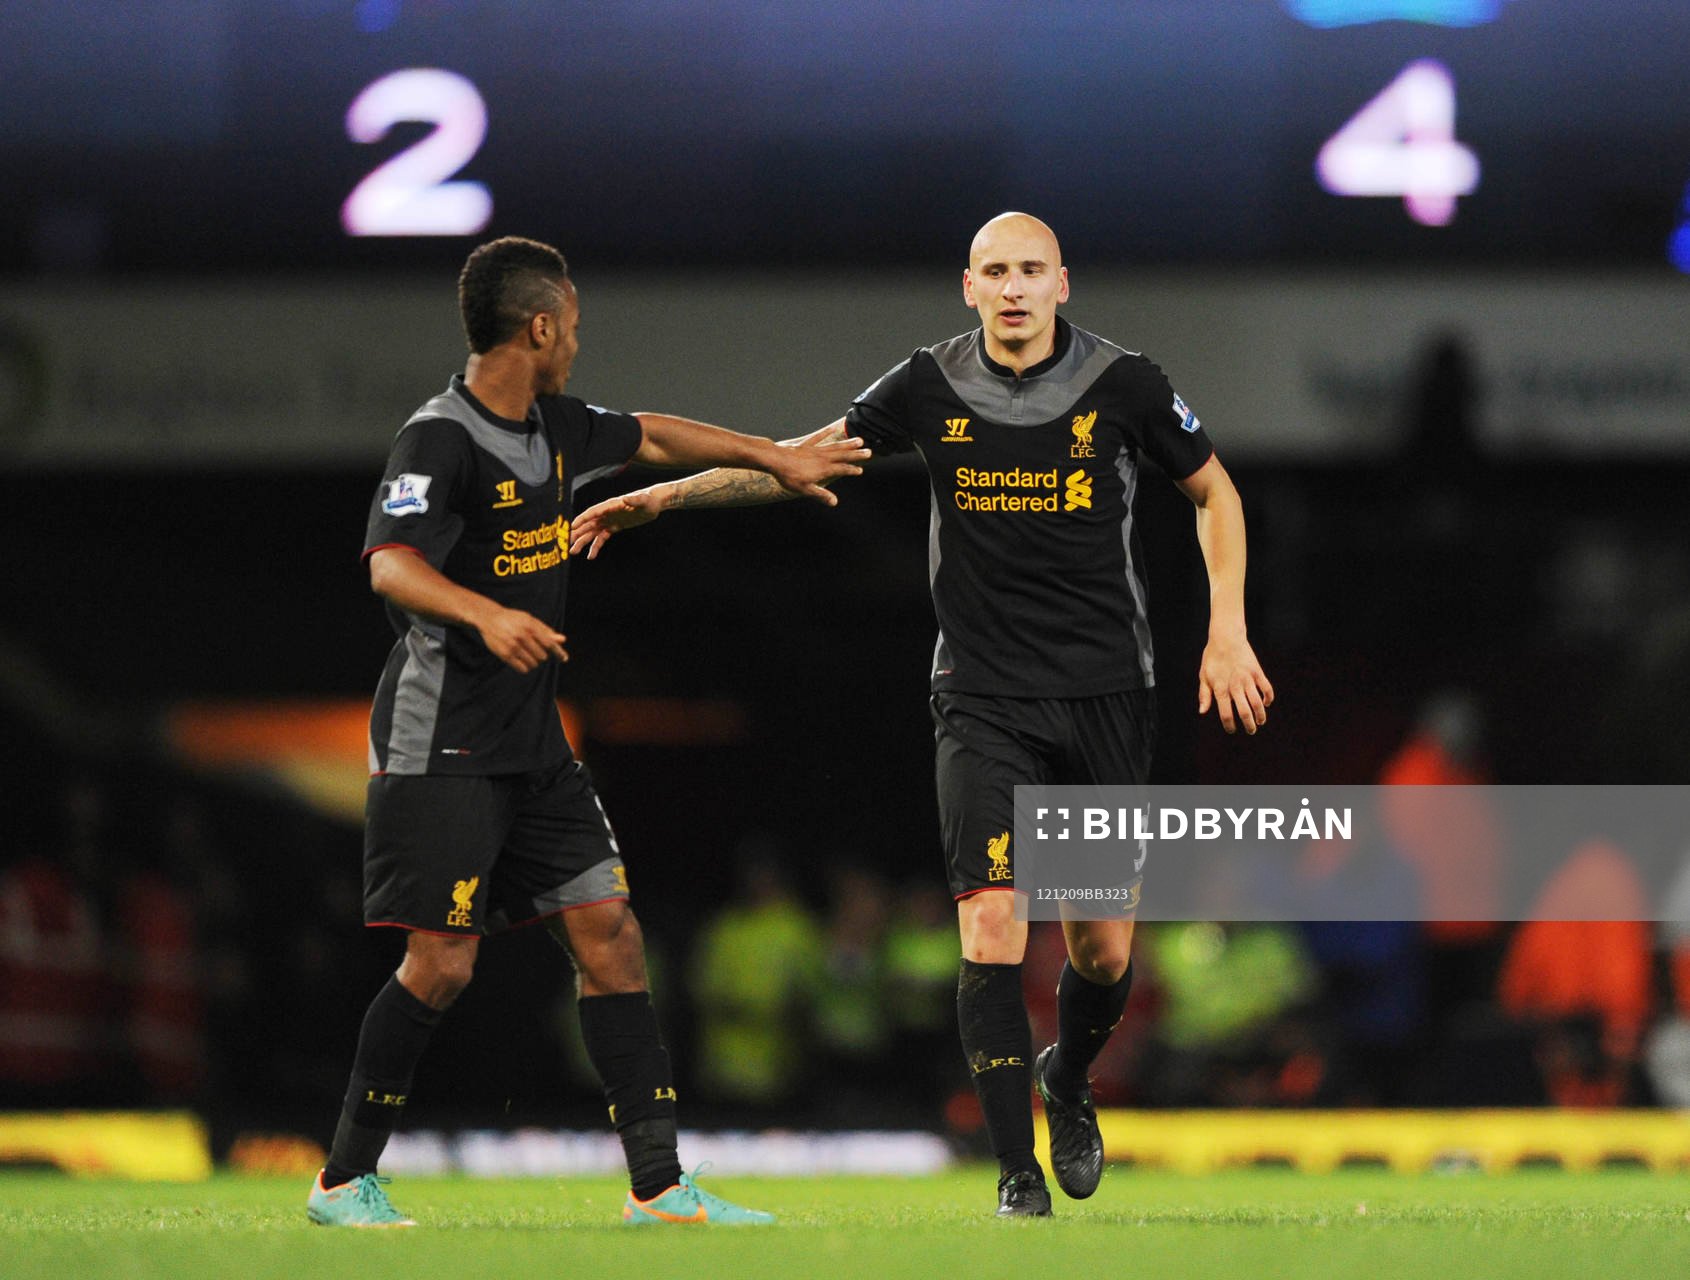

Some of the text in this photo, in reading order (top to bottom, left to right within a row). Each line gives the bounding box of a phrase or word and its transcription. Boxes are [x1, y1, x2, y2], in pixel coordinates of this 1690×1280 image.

[341, 68, 494, 236] 2
[1315, 57, 1481, 227] 4
[955, 467, 1057, 488] Standard
[955, 491, 1058, 512] Chartered
